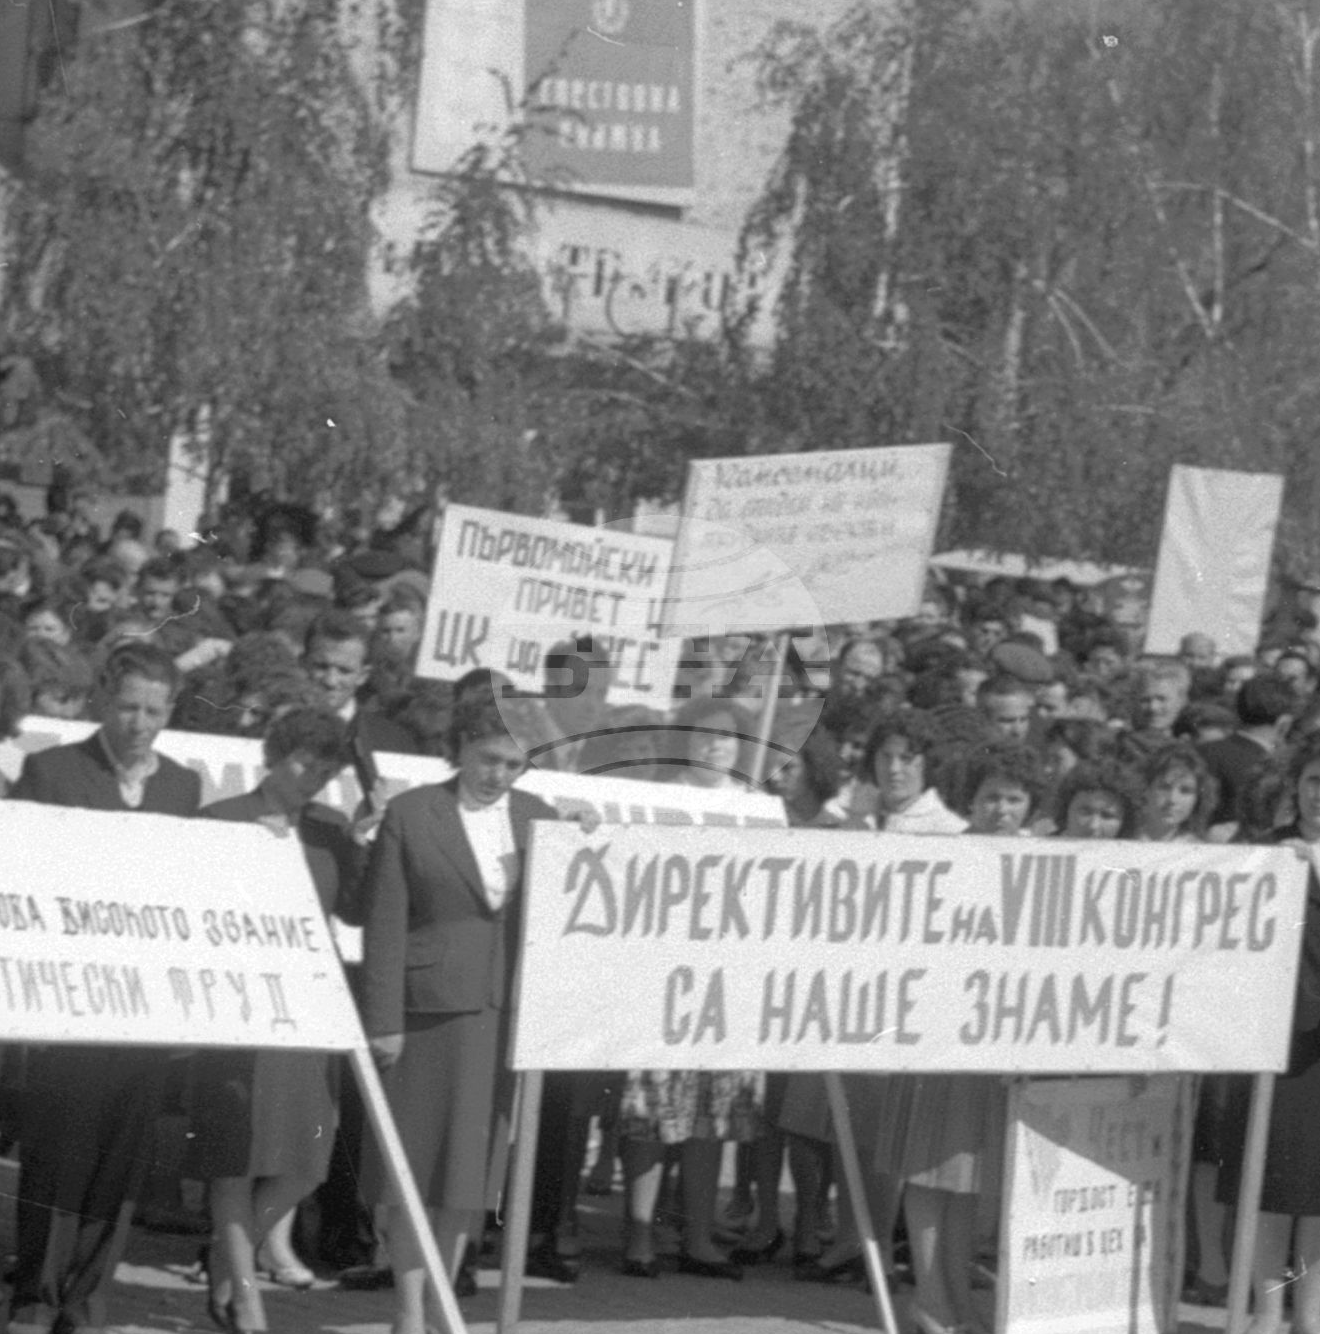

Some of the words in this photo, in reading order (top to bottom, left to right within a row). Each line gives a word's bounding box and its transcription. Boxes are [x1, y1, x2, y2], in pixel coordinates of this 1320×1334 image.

[457, 519, 659, 588] ПЪРВОМАЙСКИ
[515, 577, 626, 627] ПРИВЕТ
[433, 609, 490, 667] ЦК
[54, 896, 190, 941] ВИСОКОТО
[202, 908, 320, 953] ЗВАНИЕ
[561, 842, 951, 944] ДИРЕКТИВИТЕ
[950, 903, 999, 944] НА
[999, 853, 1077, 948] VIII
[1078, 869, 1279, 952] КОНГРЕС
[662, 964, 728, 1046] СА
[757, 967, 928, 1046] НАШЕ
[959, 969, 1177, 1048] ЗНАМЕ!
